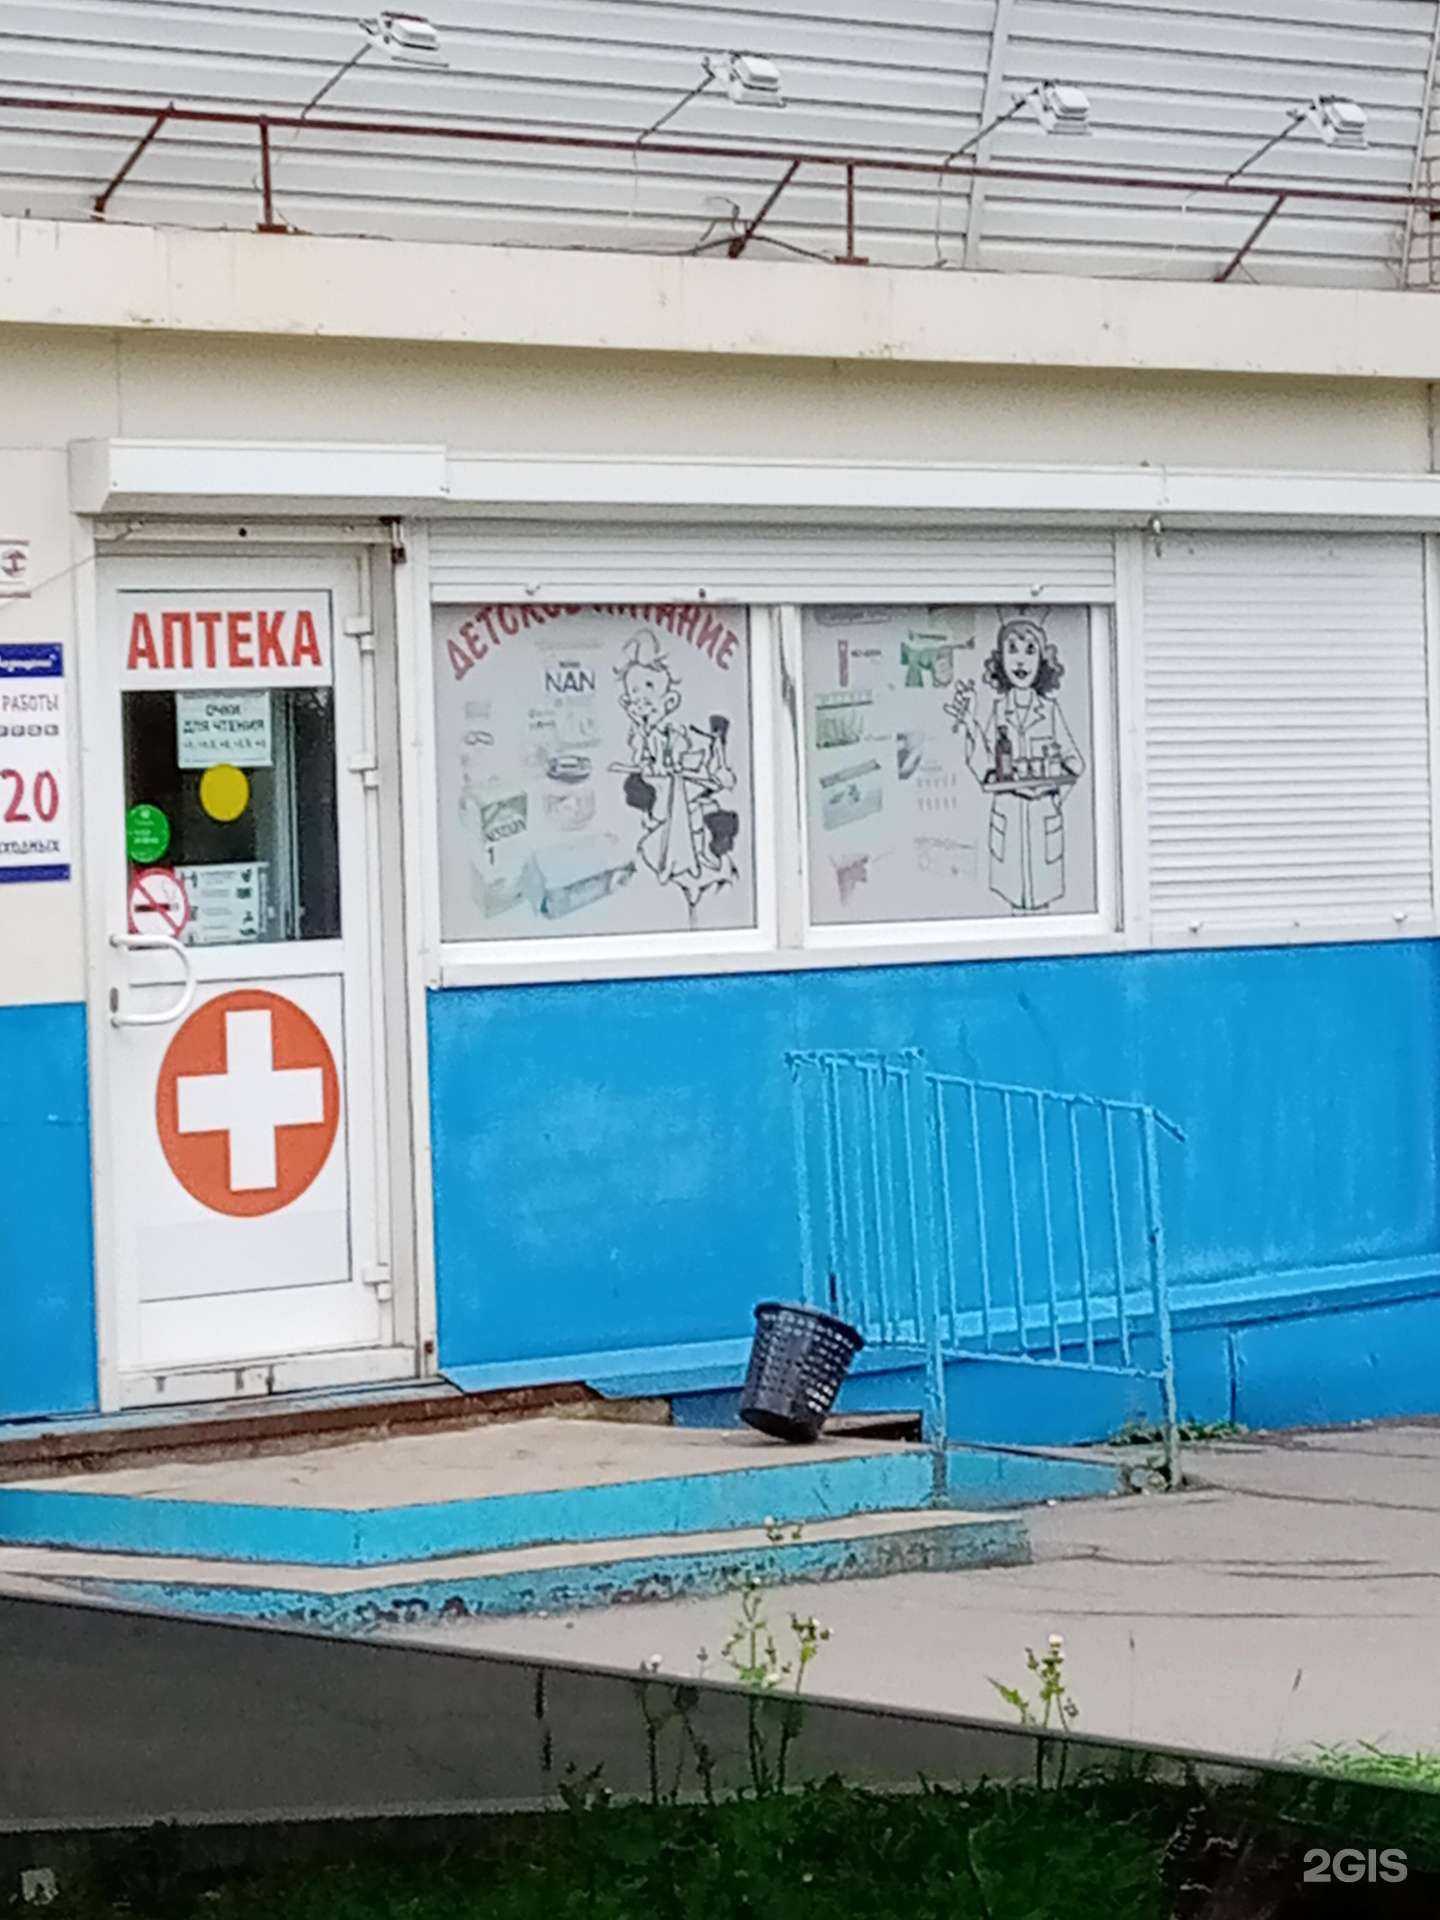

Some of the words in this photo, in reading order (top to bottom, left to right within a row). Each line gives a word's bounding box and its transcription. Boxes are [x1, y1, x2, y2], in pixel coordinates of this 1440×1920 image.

[127, 610, 323, 669] АПТЕКА
[447, 603, 582, 681] ДЕТСК
[545, 670, 596, 693] NAN
[2, 693, 60, 712] РАБОТЫ
